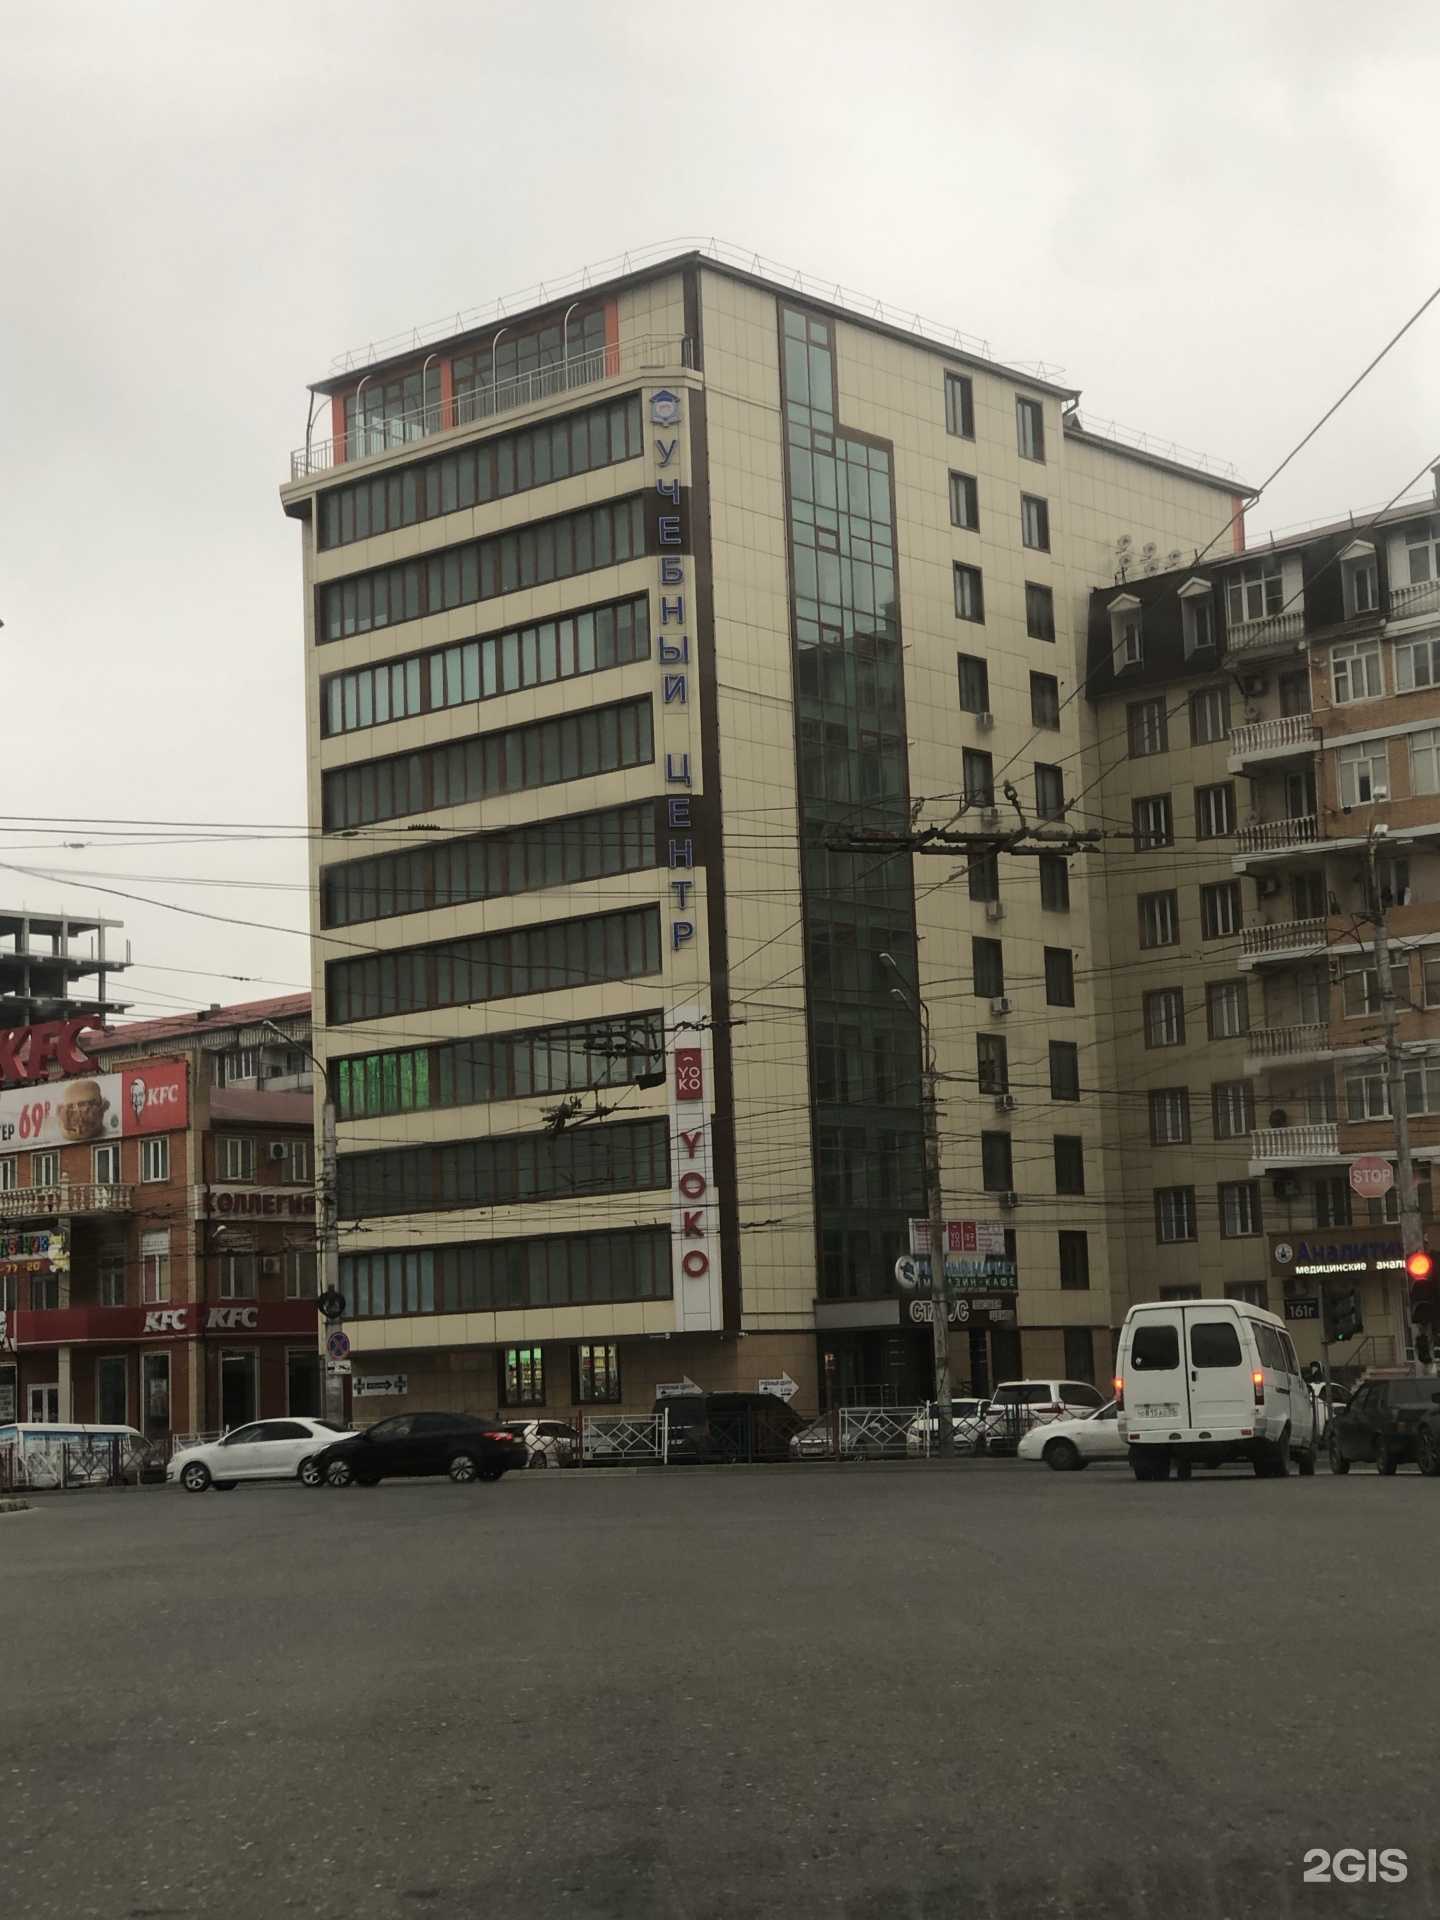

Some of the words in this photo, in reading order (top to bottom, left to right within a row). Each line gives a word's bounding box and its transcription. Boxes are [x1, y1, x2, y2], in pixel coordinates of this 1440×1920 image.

[655, 438, 689, 705] УЧЕБНЫЙ
[665, 753, 694, 953] ЦЕНТР
[147, 1084, 179, 1106] KFC
[1353, 1169, 1391, 1183] STOP
[679, 1131, 709, 1278] YOKO
[1295, 1261, 1367, 1275] медицинские
[143, 1308, 188, 1332] KFC
[207, 1307, 258, 1328] KFC
[1289, 1304, 1314, 1318] 161г
